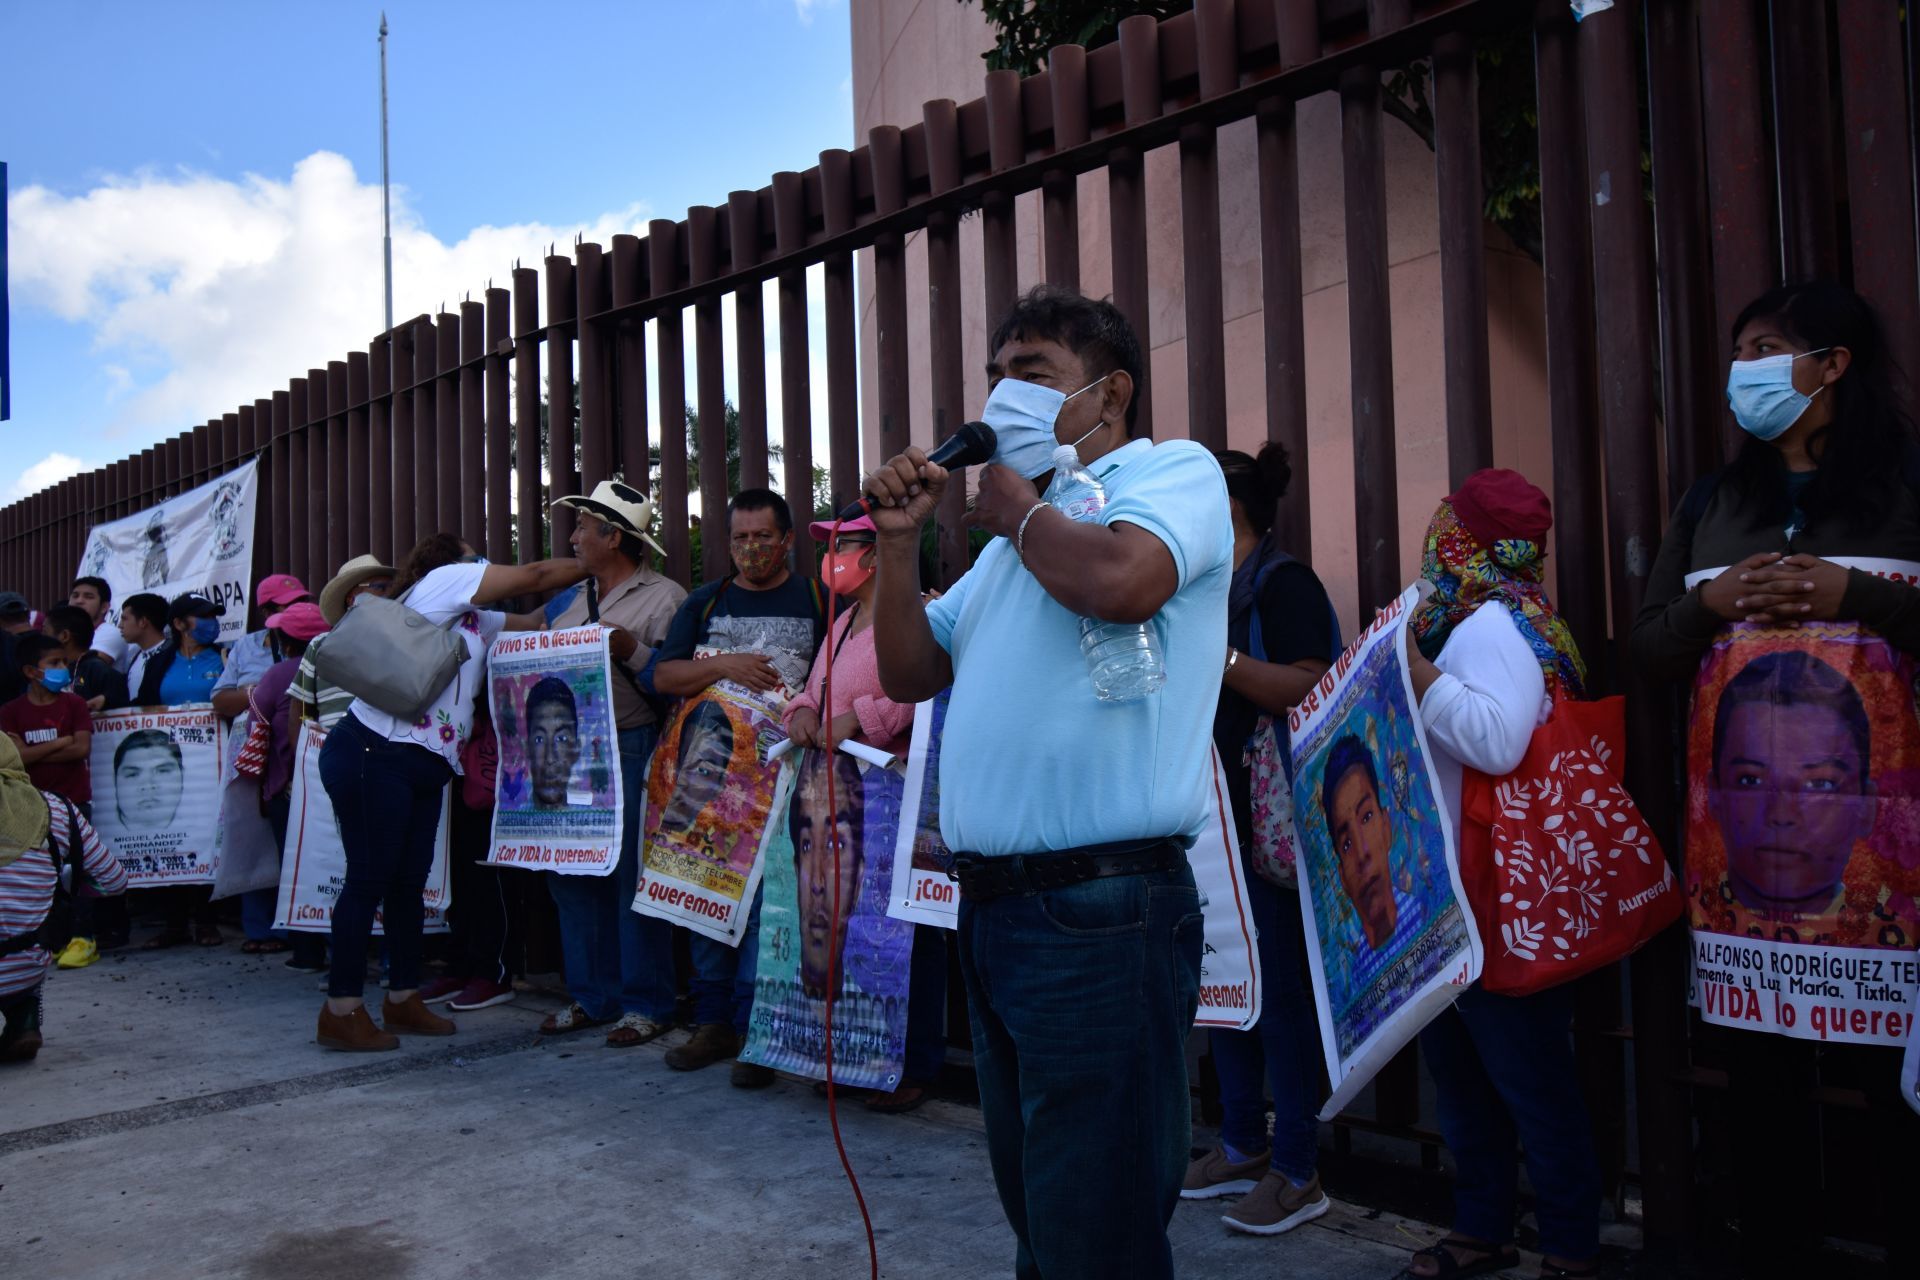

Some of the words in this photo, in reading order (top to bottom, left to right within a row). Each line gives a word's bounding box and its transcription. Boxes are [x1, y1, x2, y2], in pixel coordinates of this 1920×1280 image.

[524, 637, 537, 650] se
[540, 633, 549, 649] lo
[551, 627, 602, 647] llevaron!
[1301, 693, 1319, 720] se
[1319, 672, 1335, 701] lo
[124, 718, 138, 730] se
[142, 716, 153, 729] lo
[495, 845, 517, 864] ¡Con
[519, 845, 541, 861] VIDA
[541, 846, 552, 862] lo
[554, 847, 609, 866] queremos!
[705, 866, 743, 887] TELUMBRE
[648, 881, 731, 923] queremos!
[915, 879, 953, 903] ¡Con
[1618, 880, 1667, 916] Aurrera
[297, 905, 324, 920] ¡Con
[771, 927, 790, 961] 43
[1202, 943, 1217, 956] A
[1387, 961, 1409, 990] LUNA
[1411, 929, 1442, 967] TORRES
[1699, 941, 1763, 971] ALFONSO
[1770, 952, 1883, 982] RODRÍGUEZ
[1743, 975, 1752, 992] y
[1760, 972, 1781, 992] Luz
[1705, 982, 1763, 1022] VIDA
[1775, 991, 1796, 1028] lo
[811, 1022, 852, 1041] Barolo
